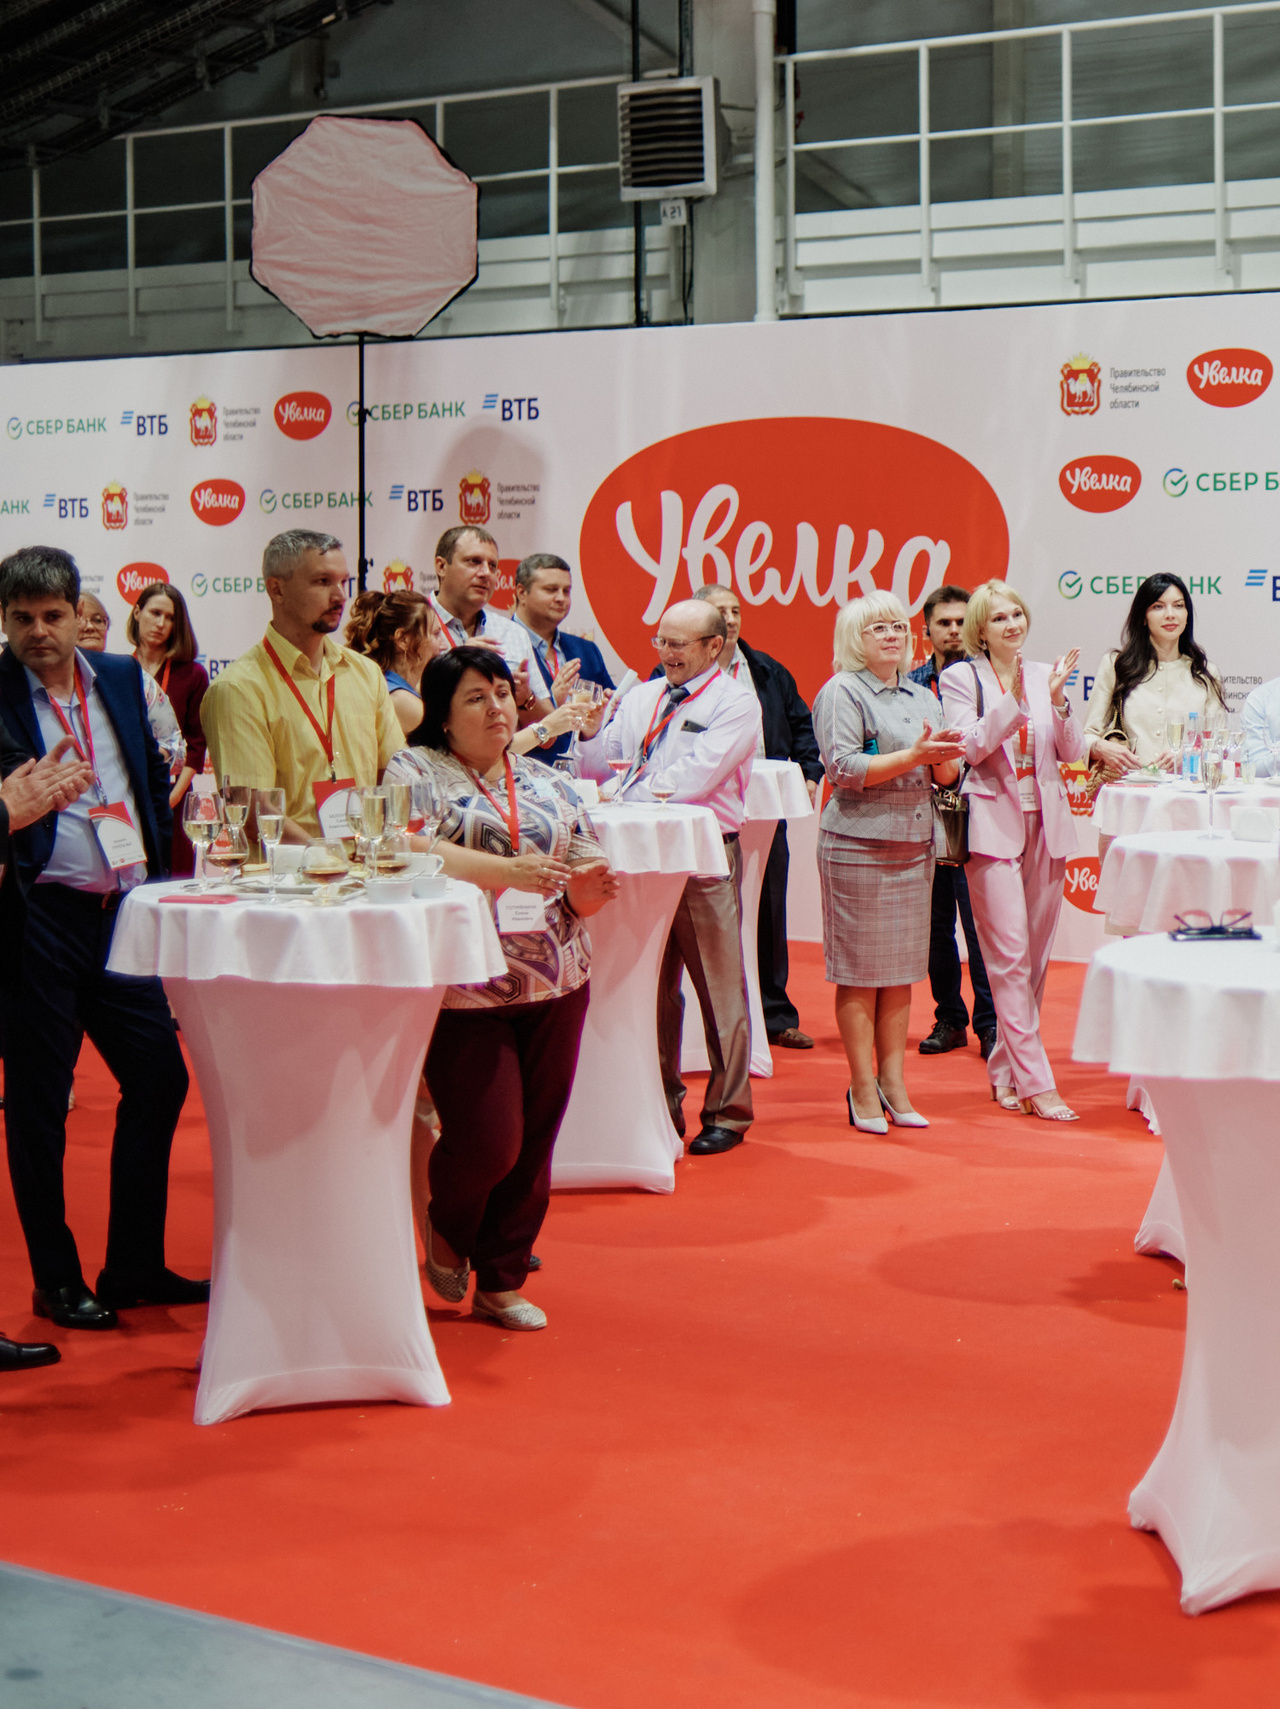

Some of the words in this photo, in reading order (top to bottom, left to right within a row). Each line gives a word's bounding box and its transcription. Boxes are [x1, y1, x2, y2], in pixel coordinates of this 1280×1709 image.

[1110, 367, 1166, 380] Правительство
[1194, 359, 1264, 389] Увелка
[1110, 383, 1159, 393] Челябинской
[279, 401, 325, 424] Увелка
[370, 402, 414, 421] СБЕР
[418, 402, 465, 419] БАНК
[502, 398, 539, 421] ВТБ
[1110, 399, 1139, 409] области
[26, 419, 63, 435] СБЕР
[67, 418, 106, 433] БАНК
[137, 415, 168, 436] ВТБ
[1066, 466, 1132, 495] Увелка
[1197, 473, 1258, 491] СБЕР
[0, 499, 31, 516] АНК
[59, 498, 89, 518] ВТБ
[195, 488, 240, 511] Увелка
[282, 492, 323, 508] СБЕР
[408, 489, 443, 511] ВТБ
[615, 483, 951, 628] Увелка
[212, 577, 252, 592] СБЕР
[1180, 576, 1222, 595] НК
